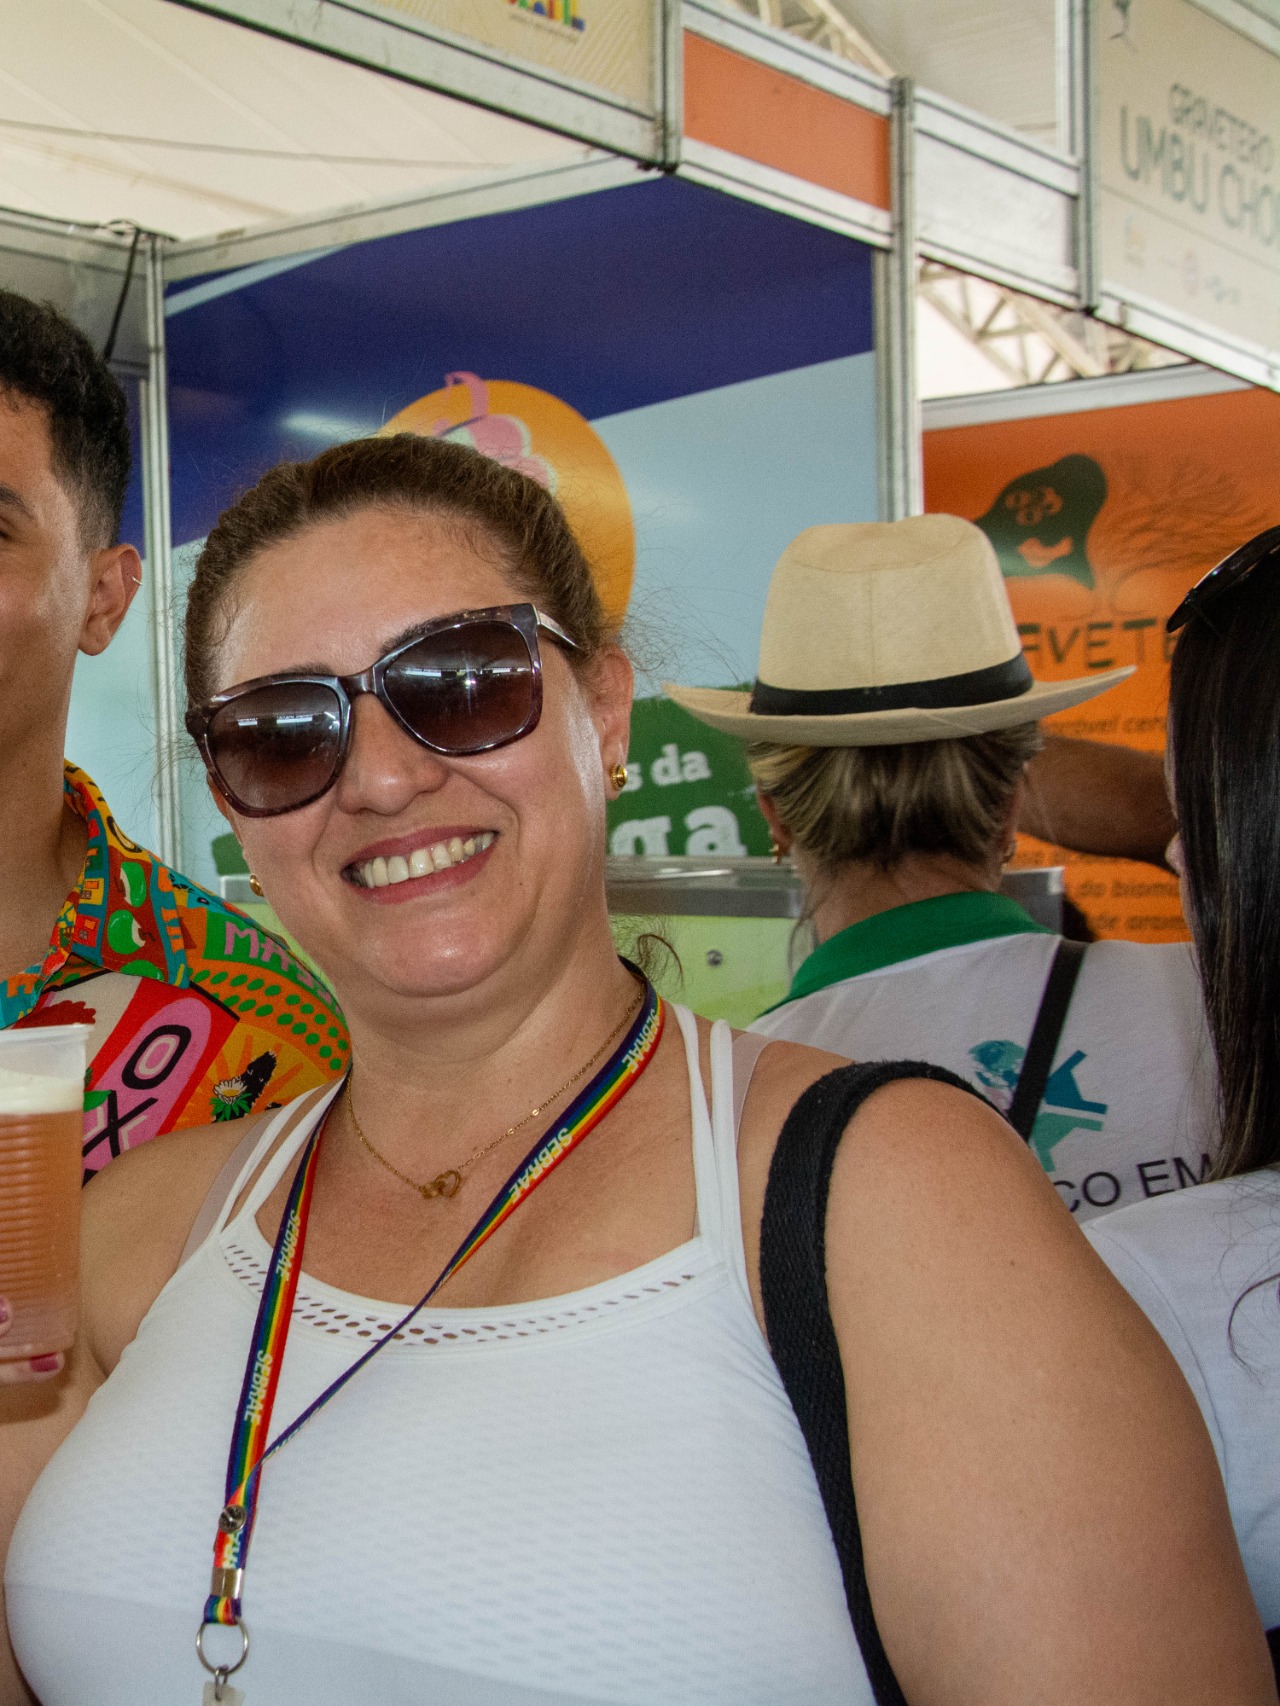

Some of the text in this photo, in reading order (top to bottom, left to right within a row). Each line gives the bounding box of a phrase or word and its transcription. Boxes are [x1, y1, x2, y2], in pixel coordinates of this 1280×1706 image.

[651, 743, 712, 786] da
[622, 1009, 660, 1073] SEBRAE
[82, 1024, 192, 1182] OX
[509, 1127, 572, 1204] SEBRAE
[275, 1209, 301, 1282] SEBRAE
[244, 1350, 273, 1426] SEBRAE
